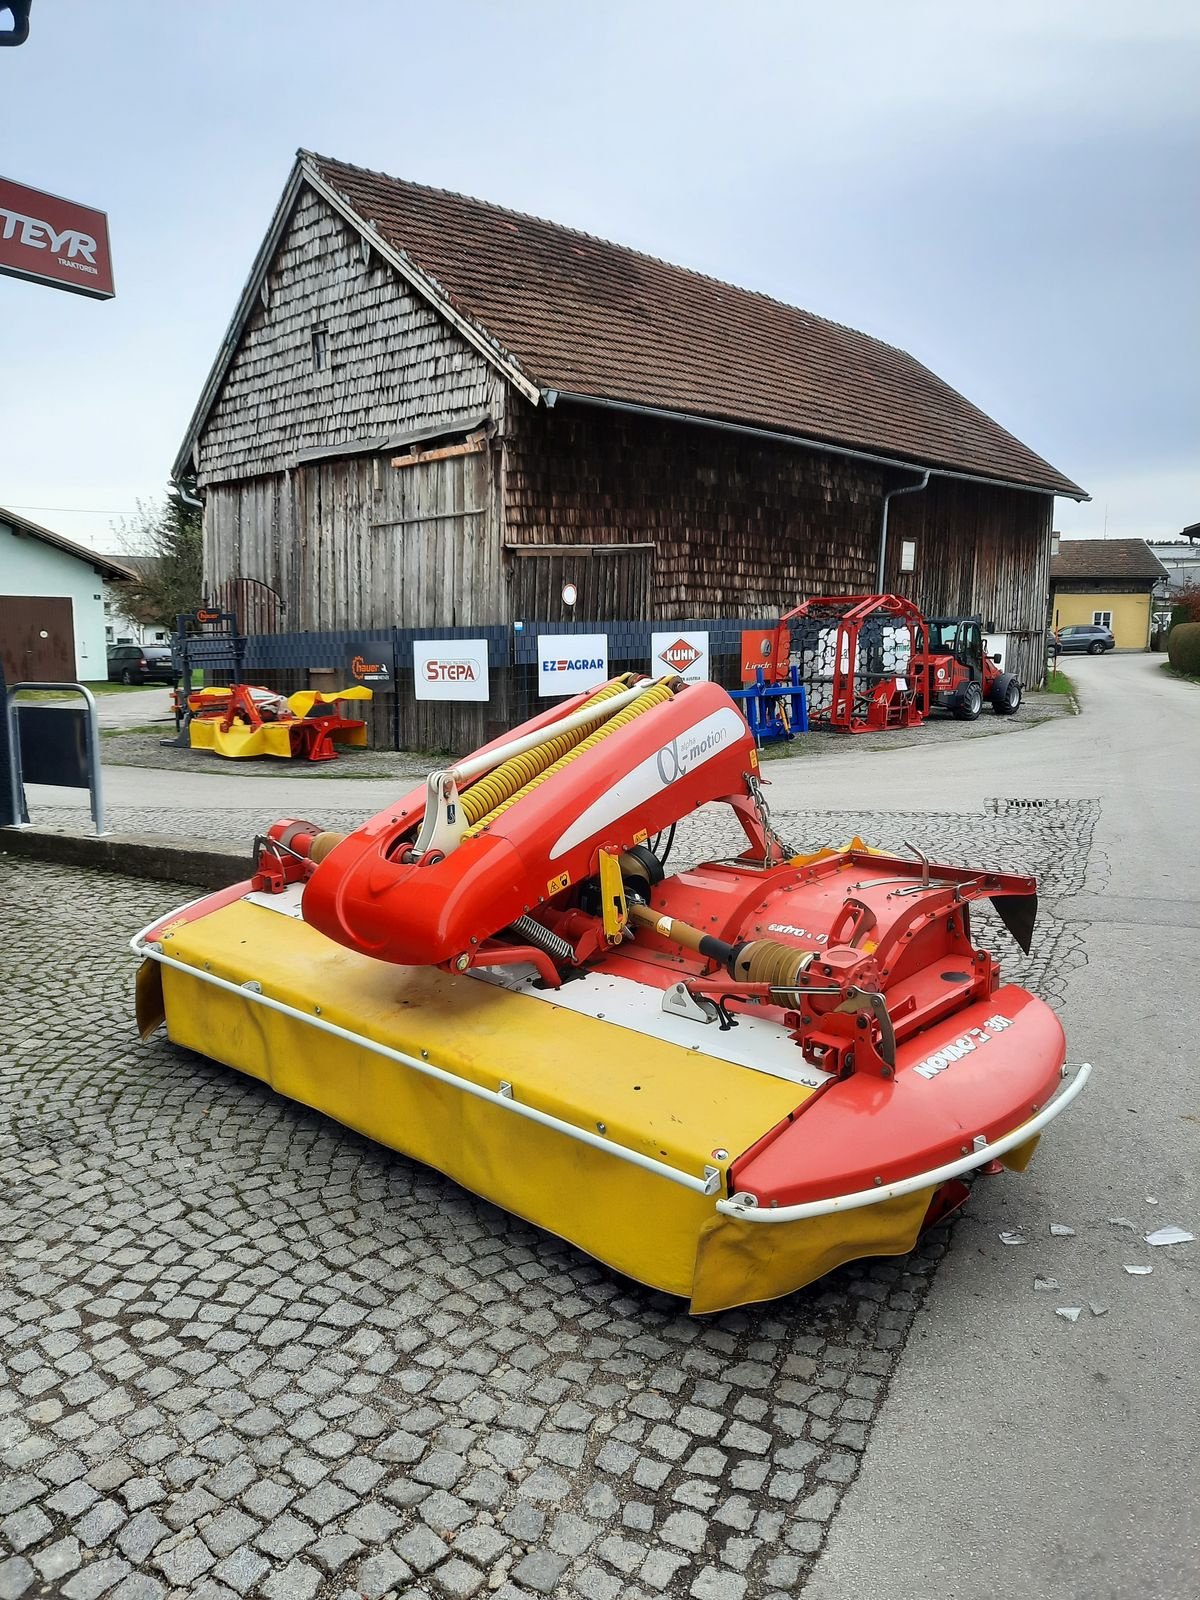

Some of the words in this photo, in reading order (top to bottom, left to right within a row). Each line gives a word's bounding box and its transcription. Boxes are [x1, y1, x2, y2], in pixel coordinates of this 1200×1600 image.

[57, 257, 98, 275] TRAKTOREN
[666, 649, 696, 661] KUHN
[426, 661, 475, 681] STEPA
